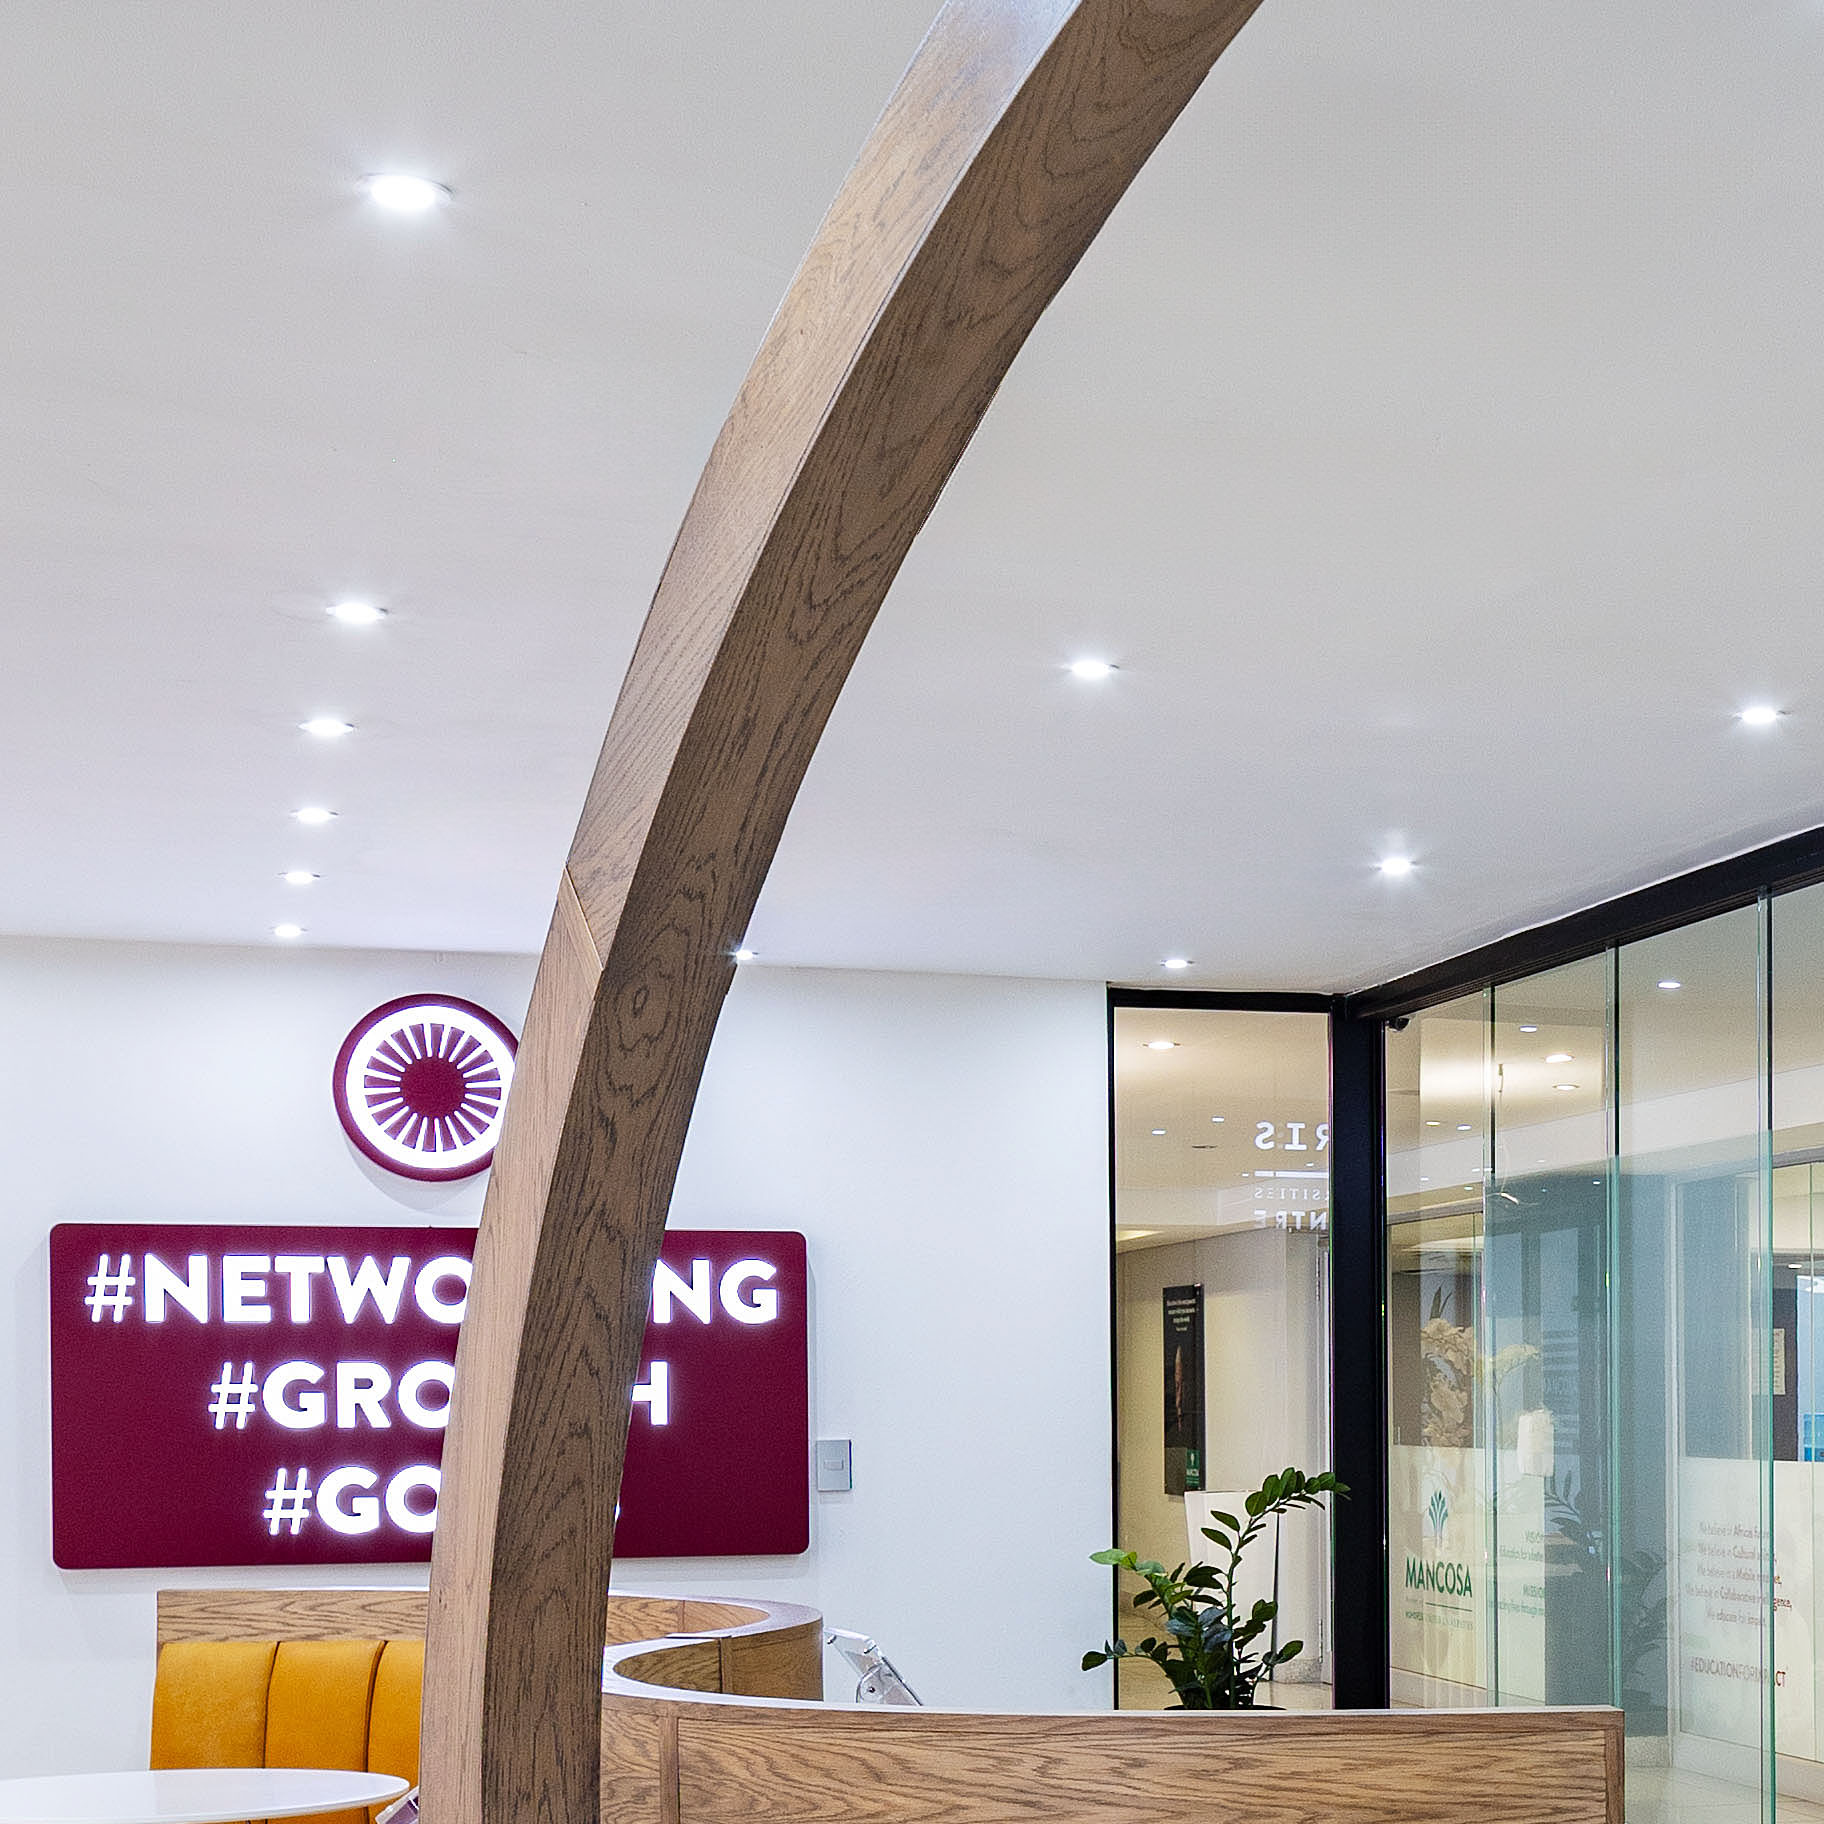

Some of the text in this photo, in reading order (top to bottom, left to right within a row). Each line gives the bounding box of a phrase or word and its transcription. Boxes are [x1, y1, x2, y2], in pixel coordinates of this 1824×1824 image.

[84, 1252, 778, 1326] #NETWONG
[208, 1360, 668, 1430] #GROH
[1405, 1556, 1473, 1598] MANCOSA
